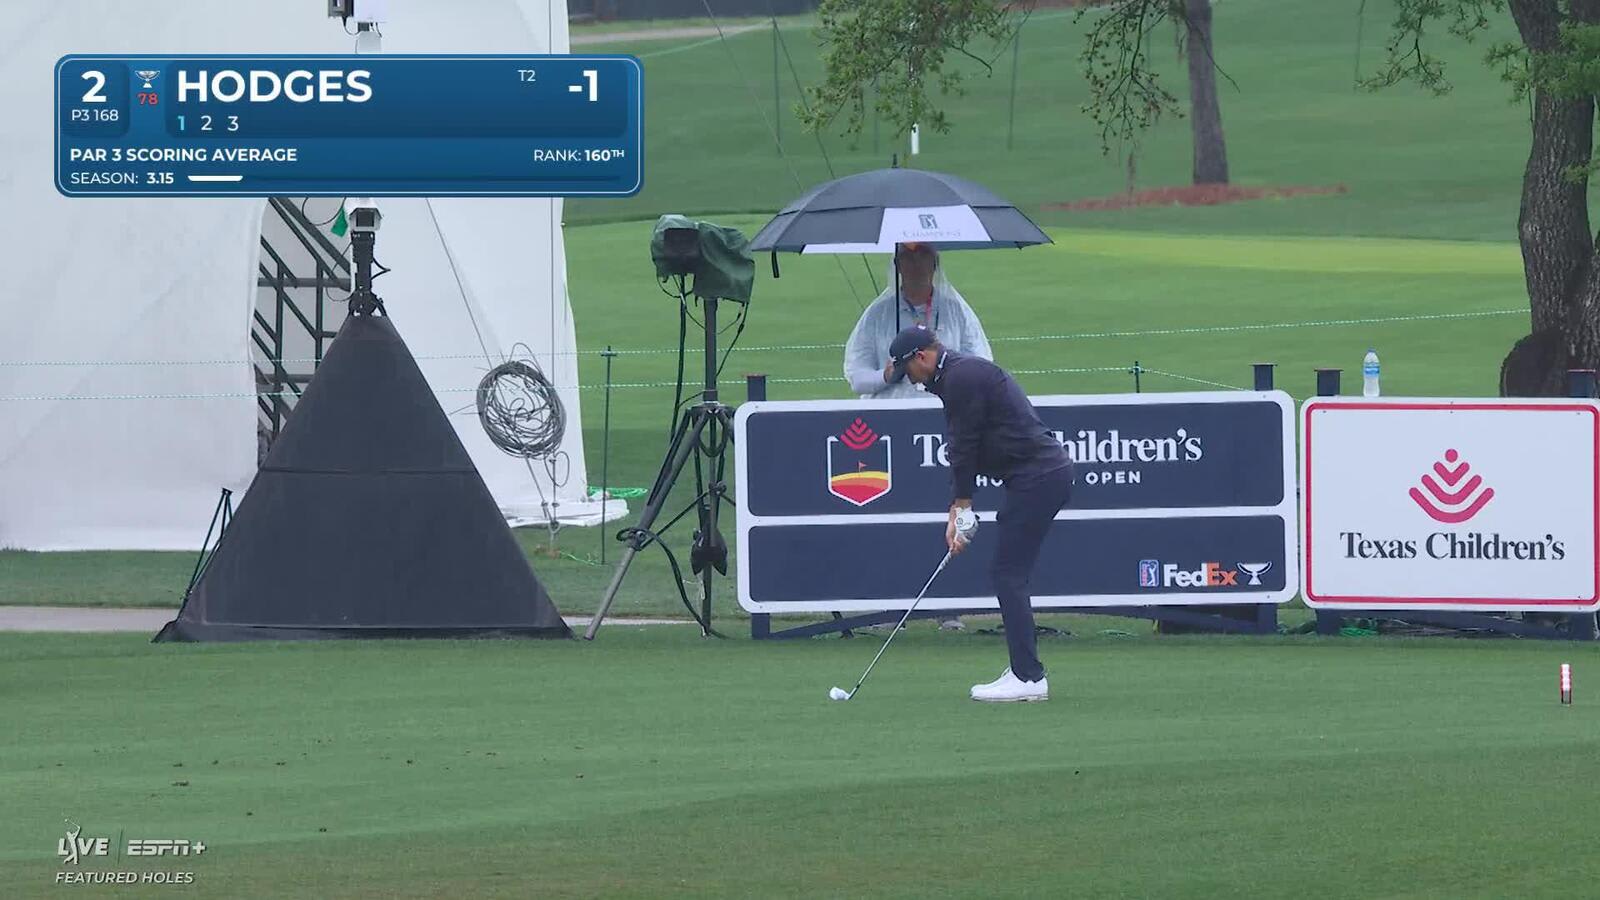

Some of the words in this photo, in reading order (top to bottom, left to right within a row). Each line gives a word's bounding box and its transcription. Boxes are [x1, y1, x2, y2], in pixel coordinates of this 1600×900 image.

[1051, 427, 1203, 464] hildren’s
[1085, 471, 1141, 485] OPEN
[1339, 532, 1417, 559] Texas
[1425, 531, 1566, 560] Children’s
[1163, 562, 1238, 588] FedEx
